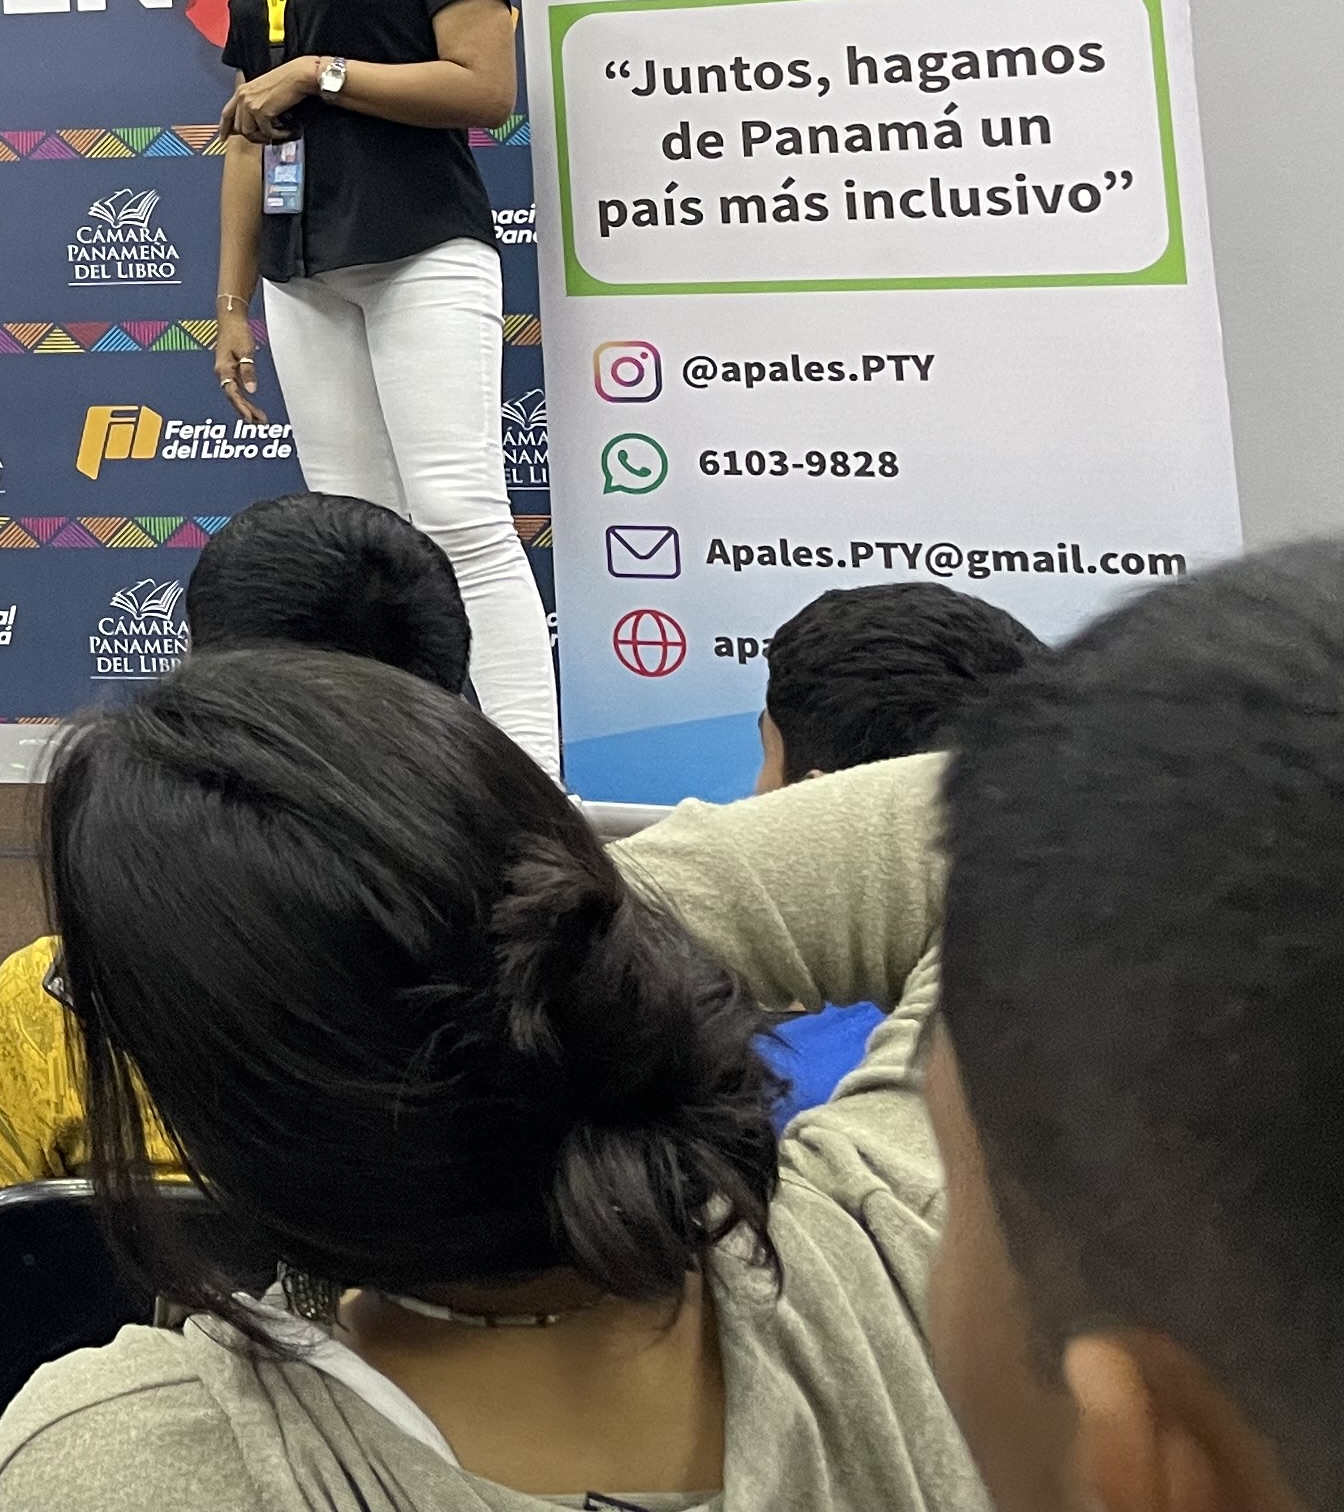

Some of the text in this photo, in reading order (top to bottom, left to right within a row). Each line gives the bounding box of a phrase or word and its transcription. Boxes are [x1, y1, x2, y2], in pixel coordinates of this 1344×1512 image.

[846, 42, 1106, 94] hagamos
[661, 101, 1051, 161] de Panamá un
[598, 180, 704, 238] país
[719, 175, 829, 224] más
[76, 222, 168, 246] CÁMARA
[67, 238, 180, 262] PANAMEÑA
[74, 261, 175, 280] DEL LIBRO
[682, 354, 935, 389] @apales.PTY
[164, 418, 227, 440] Feria
[161, 438, 292, 460] del Libro de
[699, 449, 899, 478] 6103-9828
[706, 538, 1187, 580] Apales.PTY@gmail.com
[98, 614, 190, 640] CÁMARA
[89, 636, 189, 655] PANAMEÑ
[96, 656, 134, 673] DEL
